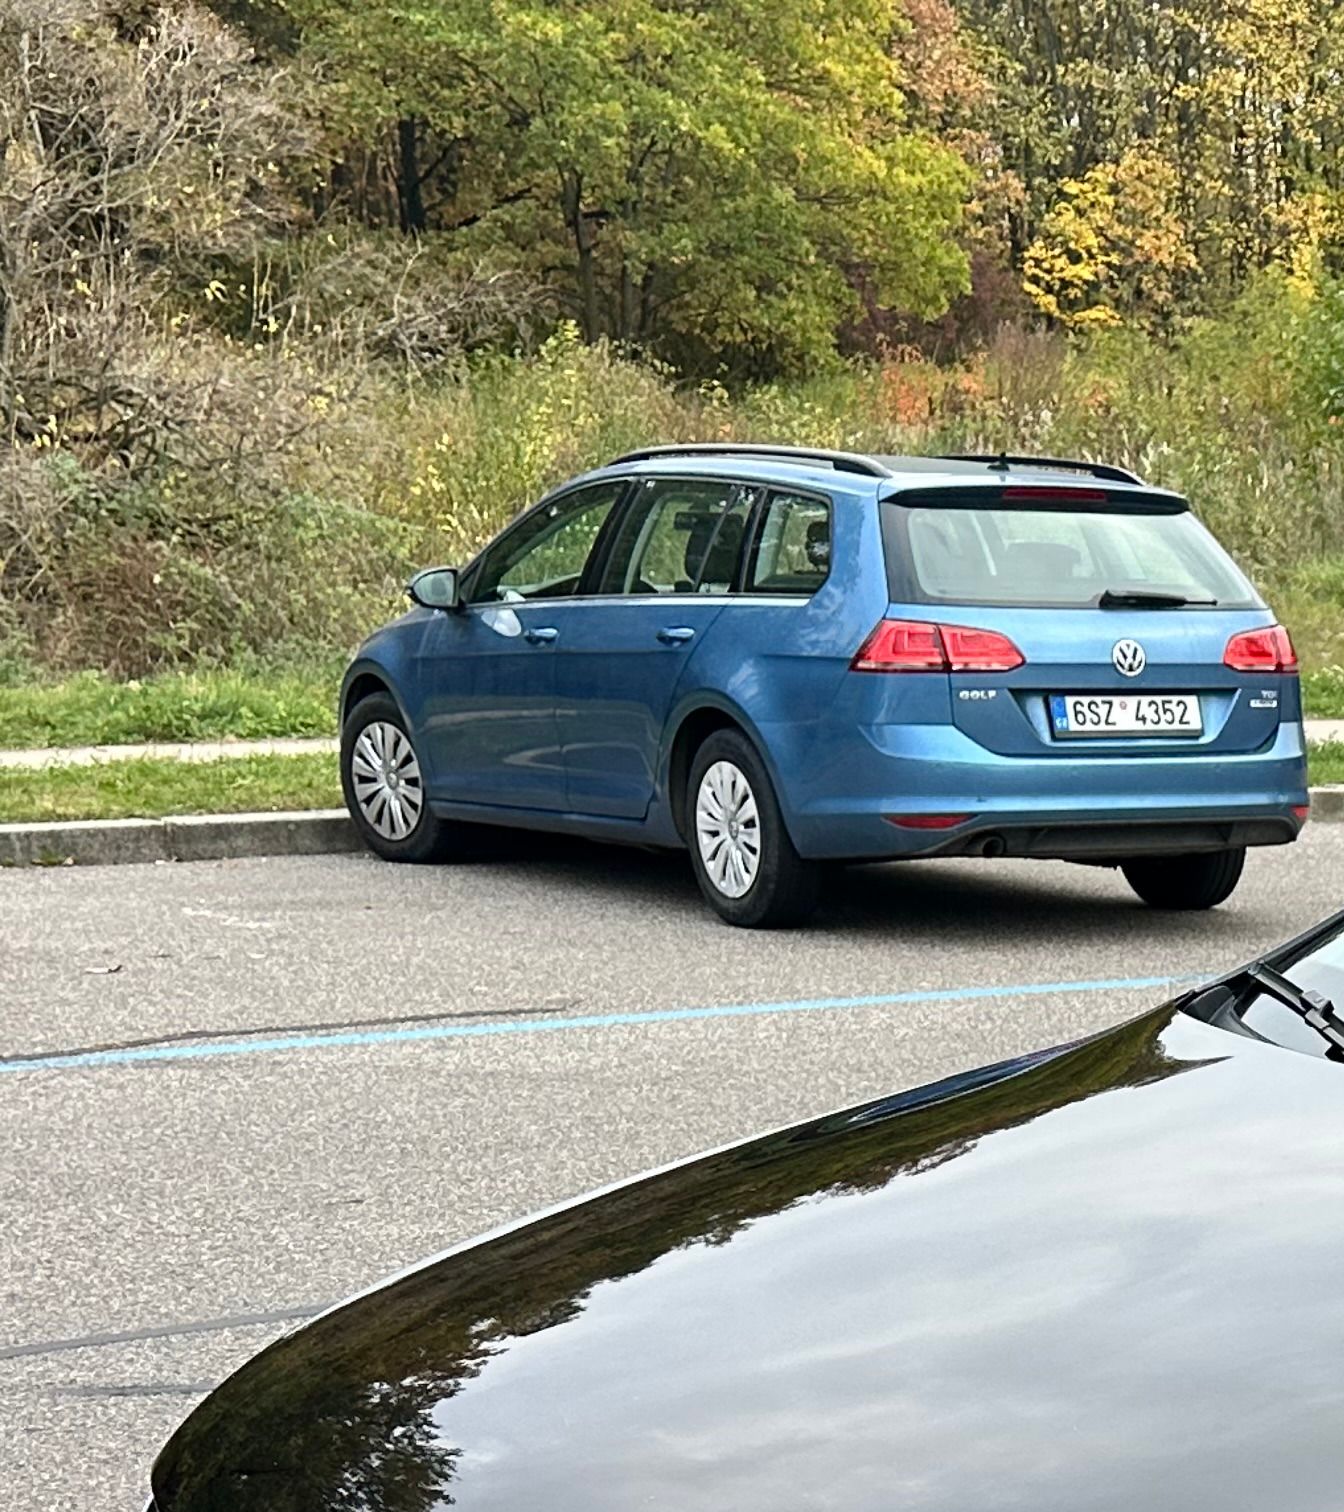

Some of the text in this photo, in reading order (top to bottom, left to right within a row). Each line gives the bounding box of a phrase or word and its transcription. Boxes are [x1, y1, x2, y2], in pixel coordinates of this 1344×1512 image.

[959, 689, 997, 701] GOLF
[1073, 701, 1118, 727] 6SZ
[1134, 699, 1192, 726] 4352
